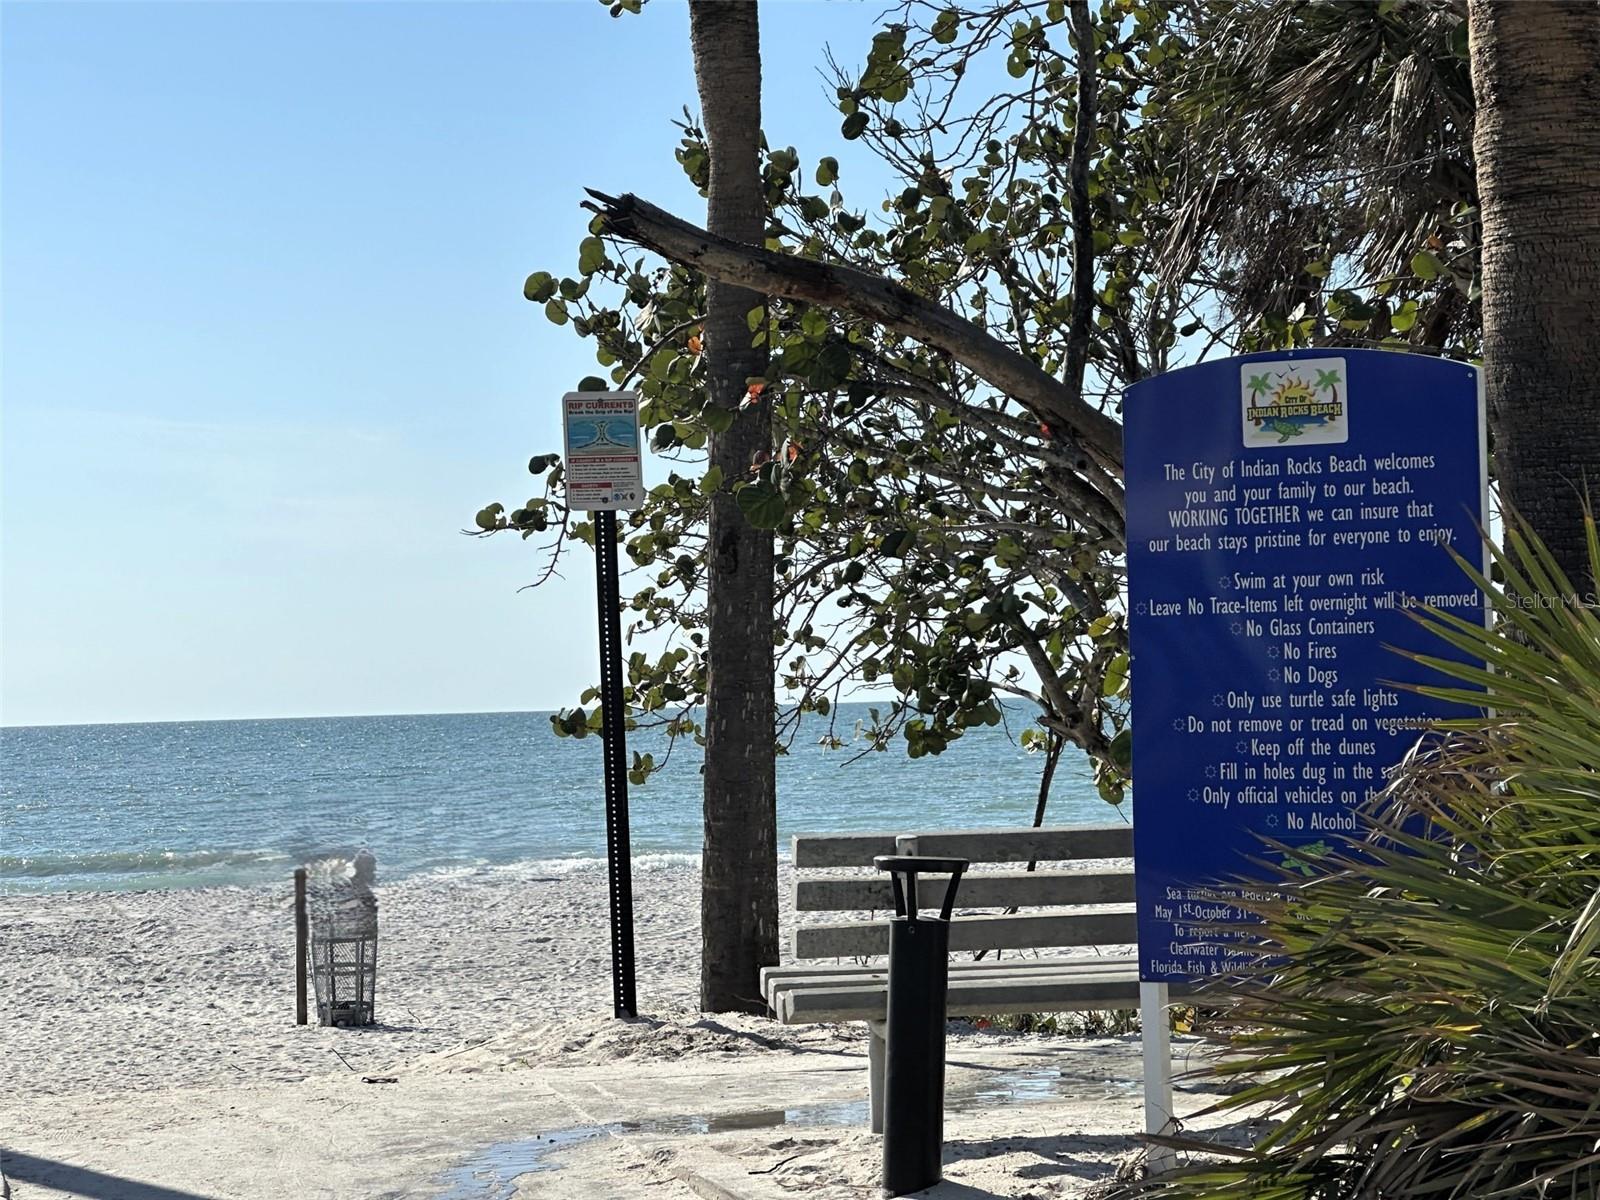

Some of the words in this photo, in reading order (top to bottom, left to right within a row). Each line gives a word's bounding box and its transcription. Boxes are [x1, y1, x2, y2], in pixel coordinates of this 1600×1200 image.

[585, 401, 634, 409] CURRENTS
[1248, 407, 1279, 420] INDIAN
[1280, 406, 1309, 418] ROCKS
[1310, 403, 1341, 416] BEACH
[1164, 464, 1185, 480] The
[1193, 462, 1215, 484] City
[1223, 461, 1234, 478] of
[1242, 459, 1279, 477] Indian
[1288, 457, 1321, 474] Rocks
[1330, 454, 1366, 472] Beach
[1375, 453, 1435, 470] welcomes
[1185, 491, 1208, 510] you
[1214, 485, 1236, 502] and
[1244, 488, 1271, 506] your
[1277, 481, 1316, 508] family
[1324, 484, 1336, 497] to
[1344, 484, 1365, 496] our
[1373, 477, 1413, 494] beach.
[1169, 507, 1227, 527] WORKING
[1235, 504, 1300, 524] TOGETHER
[1307, 510, 1323, 521] we
[1332, 509, 1352, 520] can
[1361, 503, 1398, 519] insure
[1407, 500, 1433, 517] that
[1149, 540, 1169, 552] our
[1176, 533, 1210, 550] beach
[1218, 536, 1247, 554] stays
[1256, 530, 1300, 553] pristine
[1308, 529, 1326, 545] for
[1334, 531, 1389, 549] everyone
[1399, 529, 1410, 542] to
[1418, 526, 1457, 546] enjoy.
[1235, 572, 1265, 589] Swim
[1273, 575, 1285, 588] at
[1293, 575, 1321, 593] your
[1329, 574, 1353, 586] own
[1362, 568, 1384, 585] risk
[1150, 599, 1181, 615] Leave
[1189, 598, 1203, 614] No
[1210, 596, 1277, 614] Trace-Items
[1285, 594, 1303, 611] left
[1310, 593, 1367, 615] overnight
[1374, 591, 1394, 609] will
[1401, 591, 1417, 608] be
[1424, 589, 1478, 607] removed
[1247, 620, 1262, 636] No
[1271, 619, 1301, 636] Glass
[1309, 617, 1374, 635] Containers
[1284, 643, 1300, 659] No
[1309, 642, 1336, 658] Fires
[1285, 667, 1300, 683] No
[1309, 666, 1337, 688] Dogs
[1228, 691, 1254, 713] Only
[1262, 696, 1281, 707] use
[1290, 690, 1323, 707] turtle
[1332, 689, 1355, 706] safe
[1364, 687, 1399, 711] lights
[1189, 716, 1203, 732] Do
[1212, 719, 1231, 732] not
[1239, 720, 1282, 732] remove
[1290, 720, 1303, 731] or
[1312, 714, 1343, 731] tread
[1352, 719, 1367, 730] on
[1252, 739, 1280, 760] Keep
[1288, 738, 1304, 755] off
[1312, 738, 1330, 755] the
[1339, 738, 1375, 754] dunes
[1221, 763, 1237, 779] Fill
[1245, 763, 1255, 779] in
[1264, 763, 1294, 779] holes
[1303, 763, 1326, 787] dug
[1334, 762, 1344, 778] in
[1353, 762, 1372, 779] the
[1204, 787, 1230, 808] Only
[1238, 786, 1277, 803] official
[1285, 786, 1333, 803] vehicles
[1341, 791, 1356, 803] on
[1288, 813, 1303, 829] No
[1310, 812, 1356, 830] Alcohol
[1166, 886, 1182, 900] Sea
[1155, 905, 1173, 922] May
[1174, 923, 1185, 937] To
[1169, 941, 1219, 957] Clearwater
[1151, 959, 1182, 973] Florida
[1187, 960, 1206, 974] Fish
[1210, 961, 1218, 974] &
